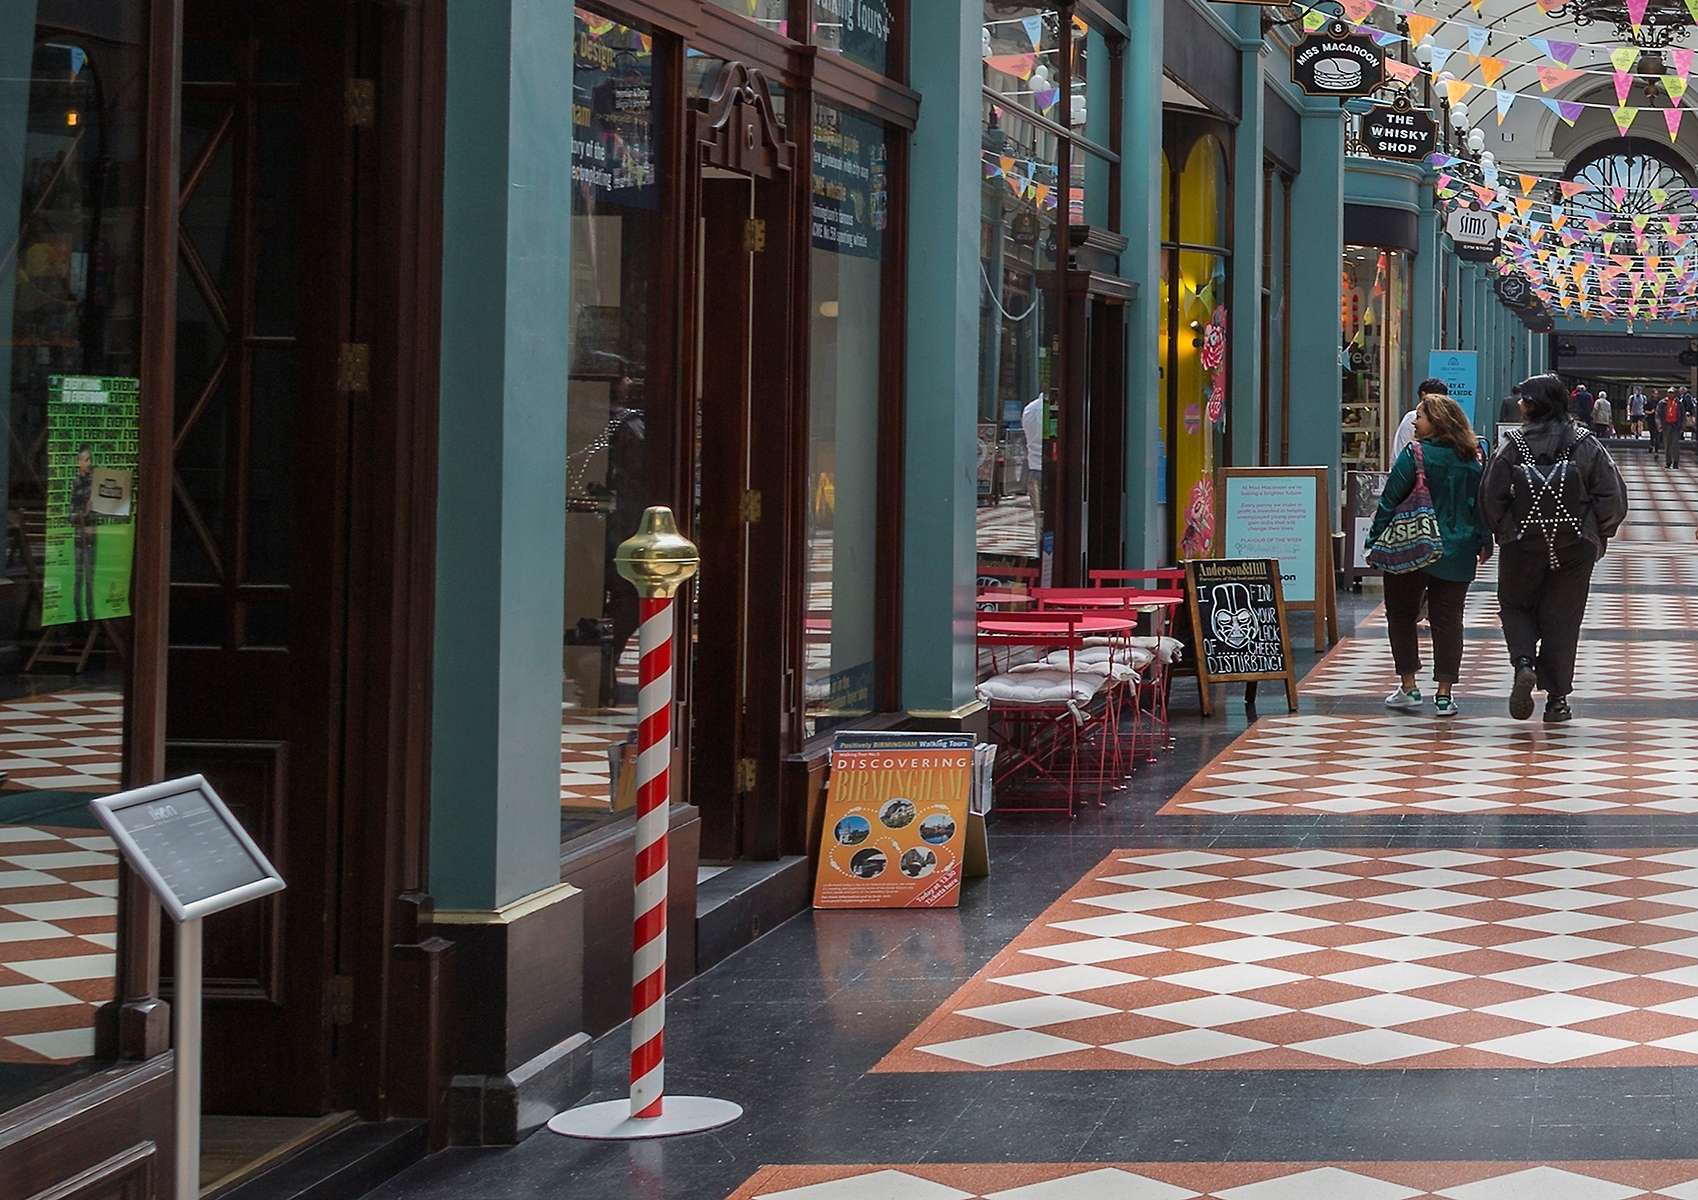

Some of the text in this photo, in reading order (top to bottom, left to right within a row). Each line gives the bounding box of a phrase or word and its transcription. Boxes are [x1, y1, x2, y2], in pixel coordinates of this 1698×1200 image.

[1335, 24, 1342, 33] 8
[1296, 43, 1380, 68] MISS MACAROON
[1386, 114, 1414, 125] THE
[1371, 125, 1429, 142] WHISKY
[1378, 142, 1417, 154] SHOP
[1460, 213, 1487, 235] sims
[1197, 585, 1209, 603] I
[1253, 607, 1277, 624] YOUR
[1258, 625, 1280, 641] LACK
[1207, 655, 1283, 673] DISTURBING!
[919, 741, 948, 749] Walking
[838, 757, 967, 769] DISCOVERING
[835, 769, 964, 801] BIRMINGHAM
